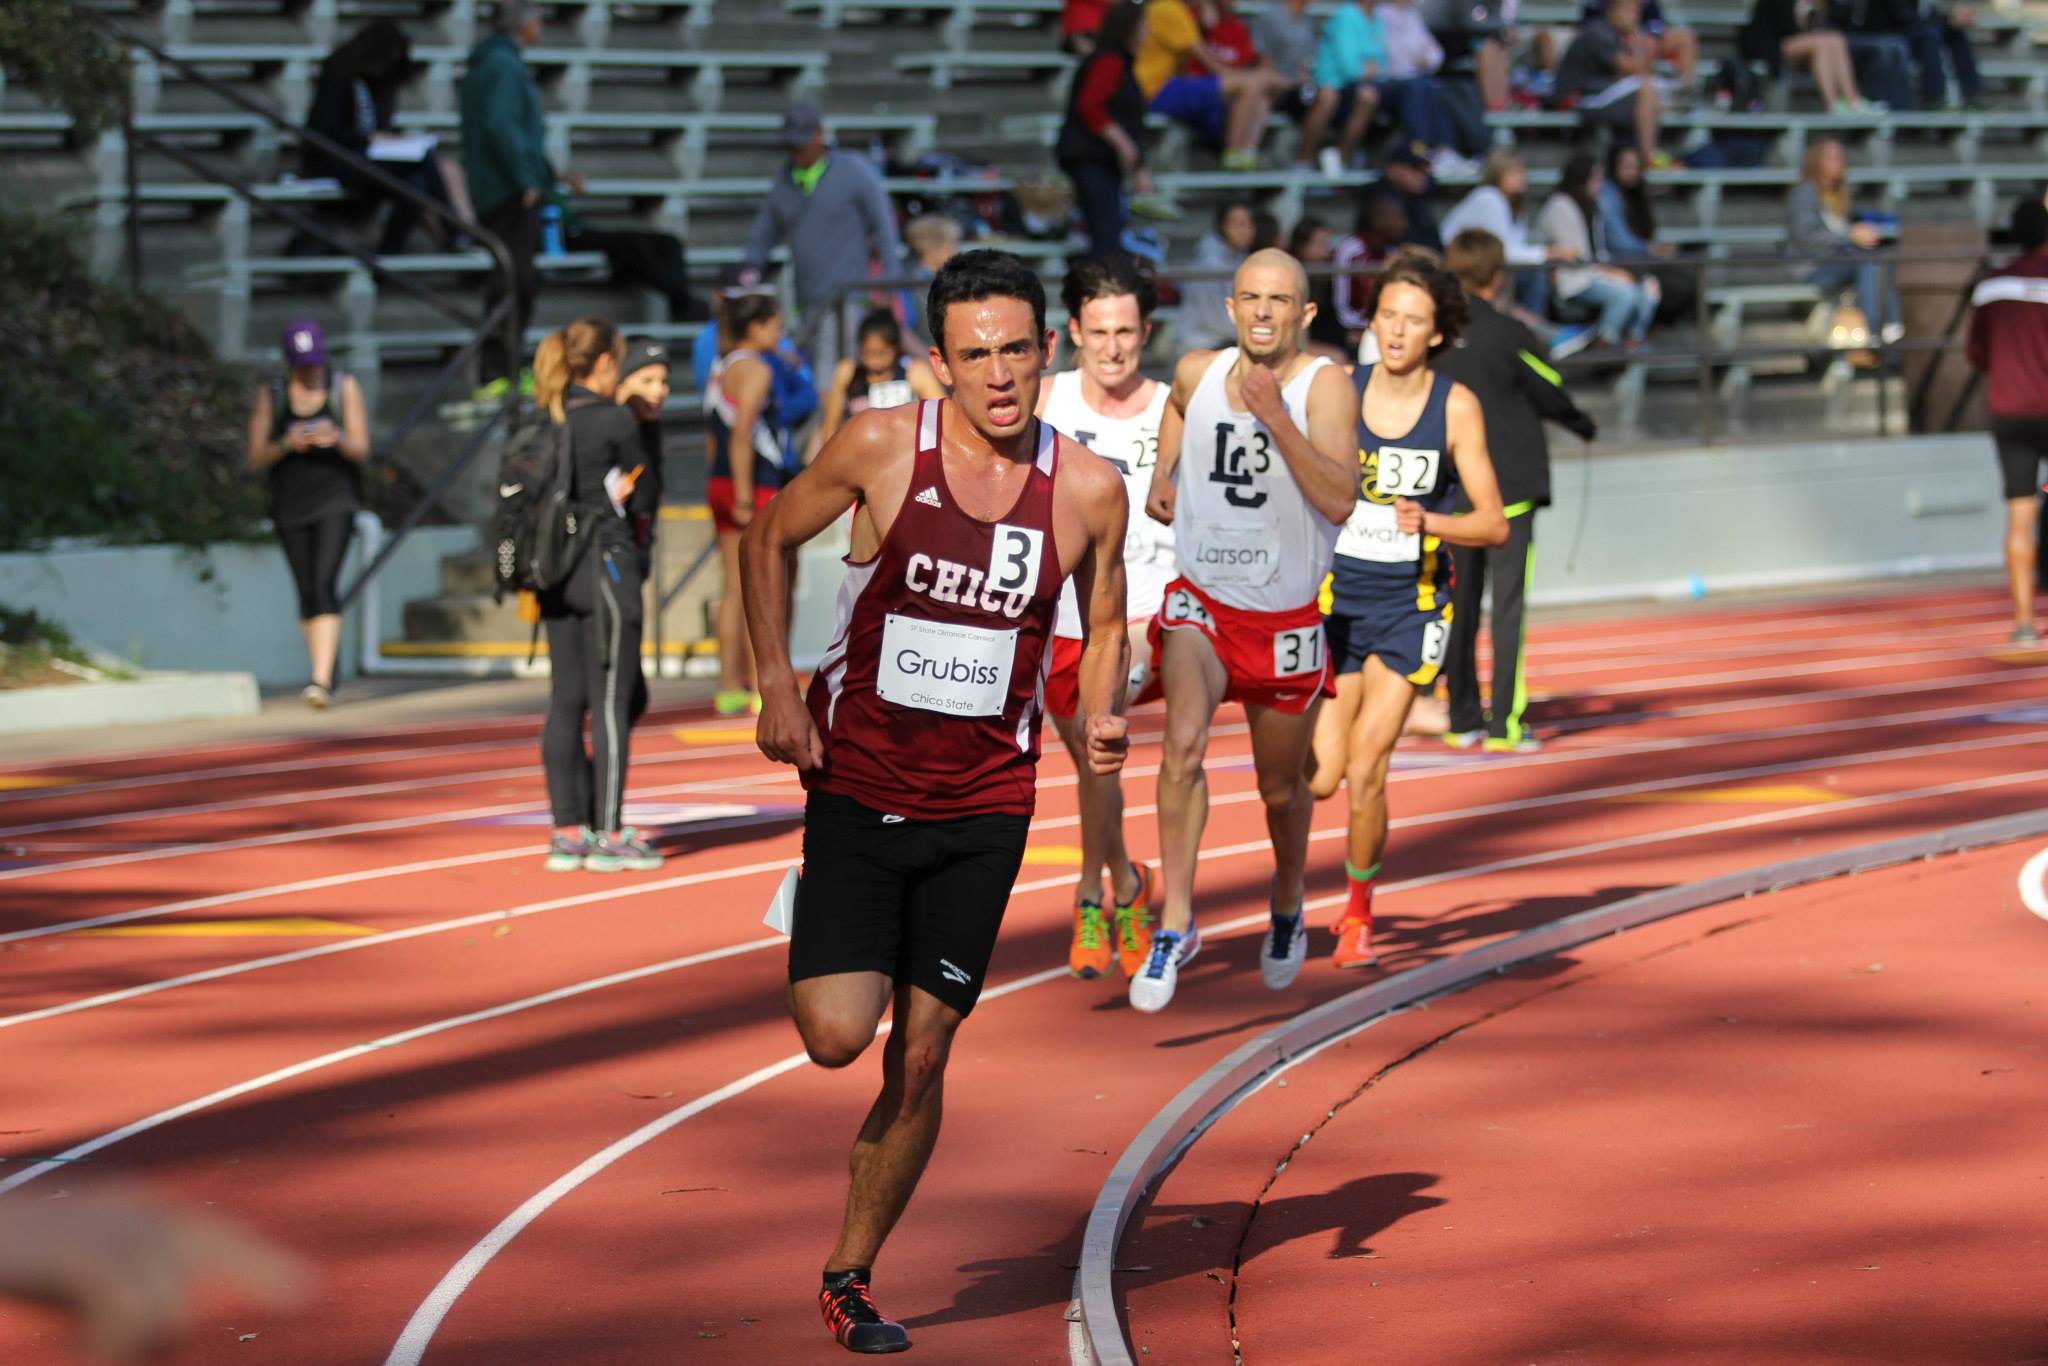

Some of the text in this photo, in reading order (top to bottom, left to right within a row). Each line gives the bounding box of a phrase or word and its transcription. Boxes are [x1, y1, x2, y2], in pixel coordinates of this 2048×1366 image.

[1386, 453, 1430, 490] 32
[998, 530, 1032, 591] 3
[1196, 540, 1269, 575] Larson
[905, 553, 1031, 619] CHICO
[896, 648, 999, 685] Grubiss
[1282, 628, 1319, 673] 31
[910, 692, 975, 711] Chico State
